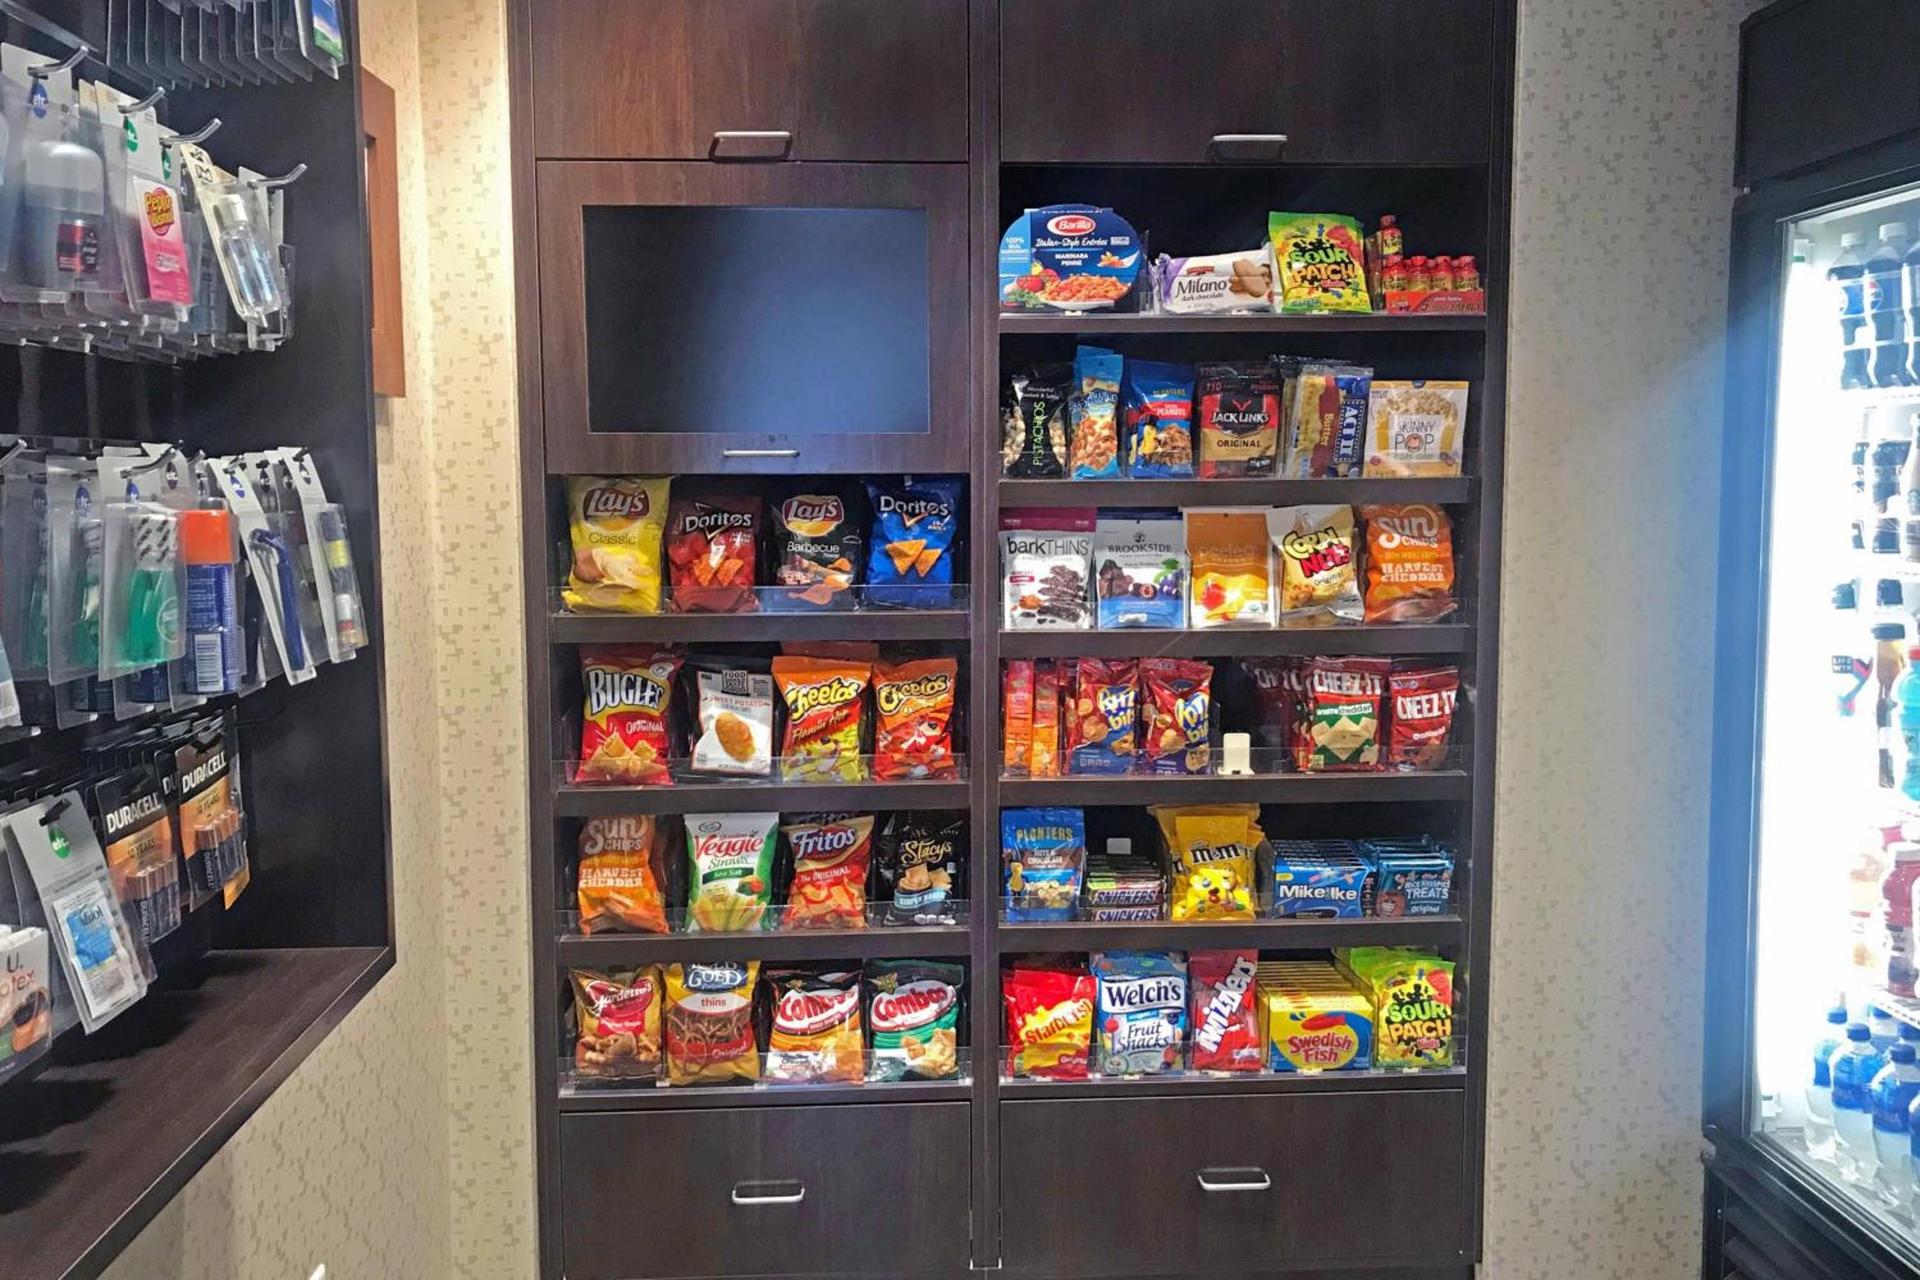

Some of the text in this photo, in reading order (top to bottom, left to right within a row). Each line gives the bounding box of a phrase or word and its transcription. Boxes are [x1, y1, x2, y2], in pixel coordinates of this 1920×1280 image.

[1058, 220, 1092, 230] Barilla
[1290, 247, 1350, 264] SOUR
[1292, 262, 1357, 286] PATCH
[1175, 278, 1228, 298] Milano
[1182, 294, 1195, 302] dark
[1212, 411, 1239, 424] JACK
[1342, 405, 1359, 437] ACT
[1032, 401, 1048, 466] PISTACHIOS
[1320, 412, 1334, 447] Butter
[1399, 420, 1437, 433] SKINNY
[1216, 439, 1262, 448] ORIGINAL
[1394, 433, 1435, 453] POP
[586, 489, 646, 517] Lay's
[787, 500, 840, 521] Lay's
[879, 495, 949, 516] Doritos
[685, 512, 753, 532] Doritos
[588, 532, 637, 545] Classic
[787, 541, 840, 553] Barbecue
[1007, 536, 1090, 556] barkTHINS
[1107, 543, 1173, 553] BROOKSIDE
[1380, 562, 1445, 574] HARVEST
[1313, 570, 1345, 587] Original
[1380, 573, 1446, 583] CHEDDAR
[724, 671, 746, 679] FOOD
[587, 668, 665, 716] BUGLES
[785, 678, 861, 722] Cheetos
[877, 675, 948, 713] Cheetos
[708, 696, 765, 708] SWEET POTATO
[626, 720, 665, 735] ORIGINAL
[182, 751, 228, 794] DURACELL
[105, 791, 162, 834] DURACELL
[792, 827, 858, 858] Fritos
[1016, 827, 1074, 843] PLANTERS
[604, 837, 642, 852] CHIPS
[694, 834, 765, 859] Veggie
[900, 839, 953, 865] Stacy's
[581, 867, 644, 878] HARVEST
[812, 865, 852, 881] ORIGINAL
[578, 877, 644, 889] CHEDDAR
[1092, 889, 1157, 905] SNICKERS
[1279, 884, 1358, 900] Mike Ike
[1405, 887, 1449, 900] TREATS
[1410, 904, 1441, 915] Original
[701, 996, 727, 1007] thins
[1105, 980, 1182, 1008] Welch's
[779, 990, 857, 1022] Combos
[873, 986, 948, 1022] Combos
[1387, 1000, 1447, 1023] SOUR
[1127, 1021, 1162, 1039] Fruit
[1388, 1018, 1452, 1045] PATCH
[712, 1043, 748, 1060] Original
[1118, 1033, 1170, 1054] Snacks
[1288, 1032, 1354, 1055] Swedish
[1302, 1048, 1340, 1063] Fish
